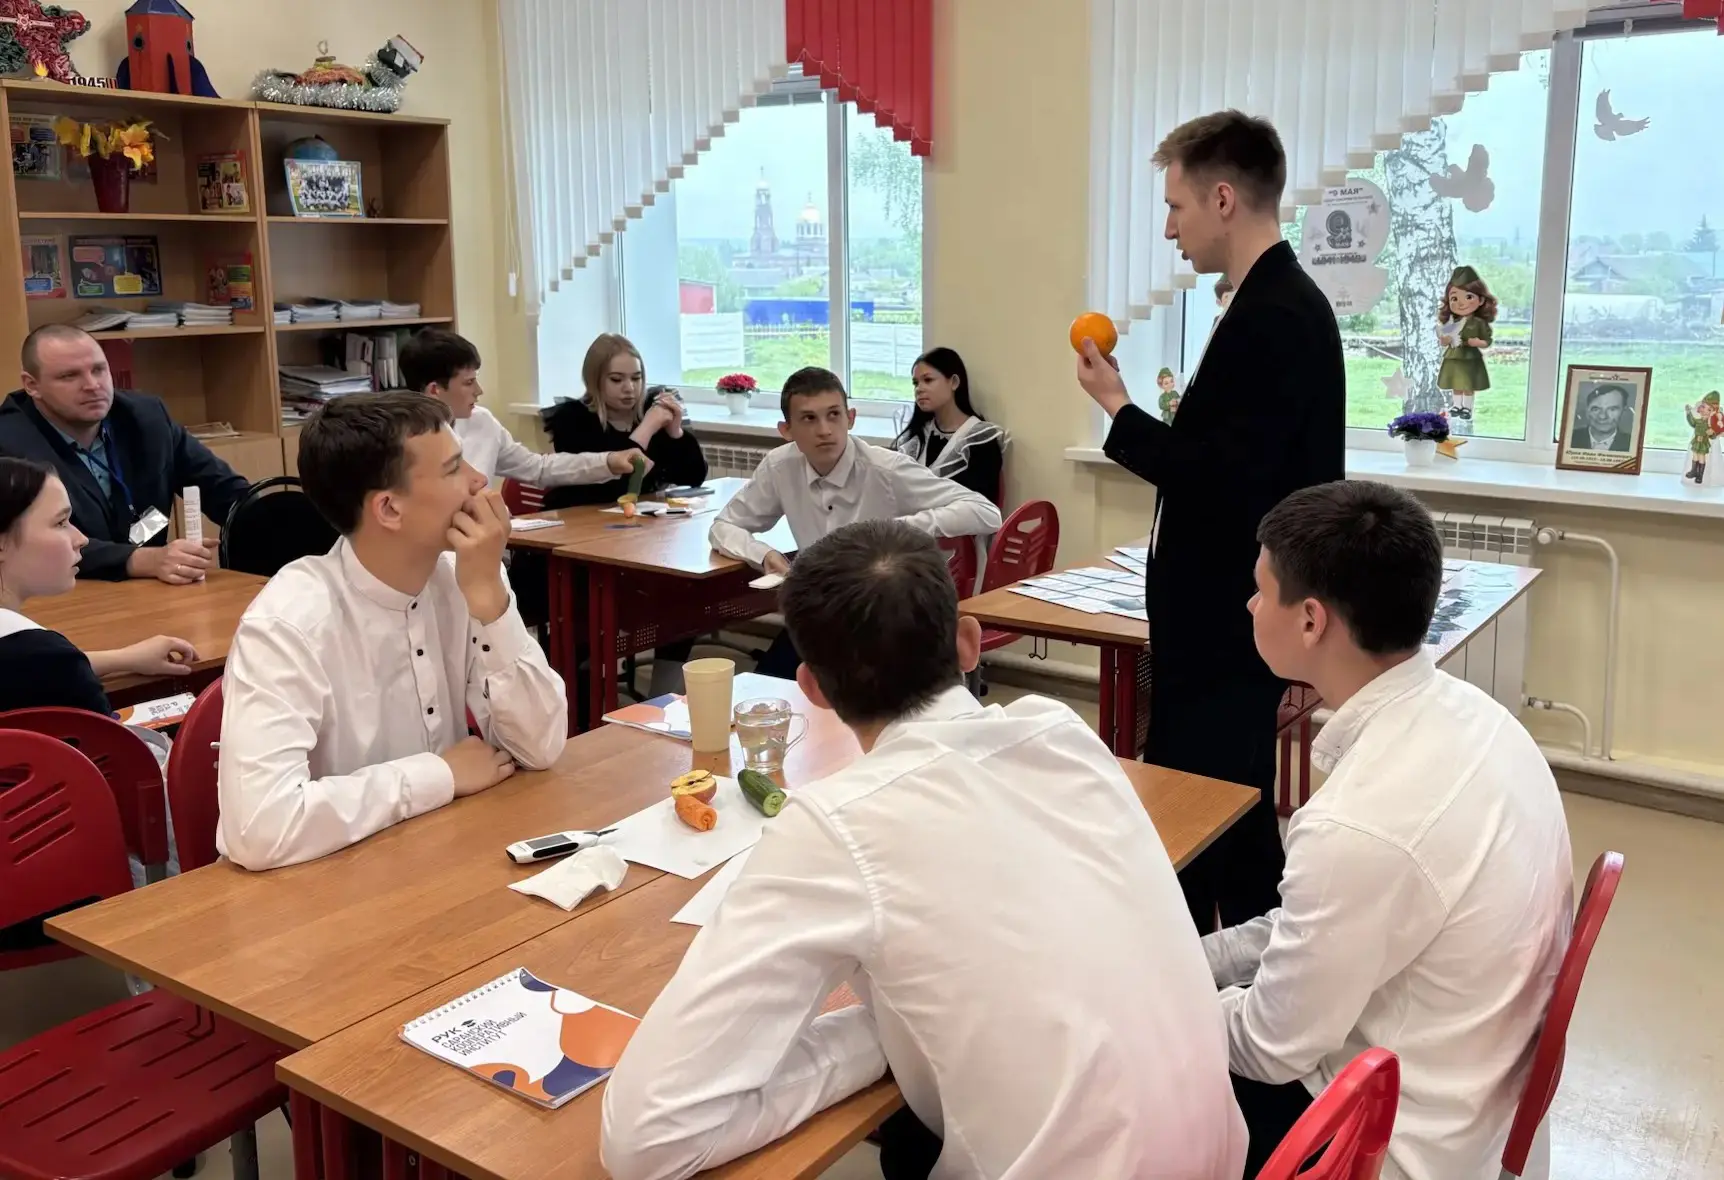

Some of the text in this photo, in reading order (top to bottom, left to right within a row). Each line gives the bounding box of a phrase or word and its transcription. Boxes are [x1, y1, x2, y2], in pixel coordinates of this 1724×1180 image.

[71, 76, 105, 88] 1945
[431, 1027, 462, 1043] РУК
[442, 1019, 497, 1048] САРАНСКИЙ
[450, 1012, 527, 1053] КООПЕРАТИВНЫЙ
[459, 1030, 507, 1056] ИНСТИТУТ
